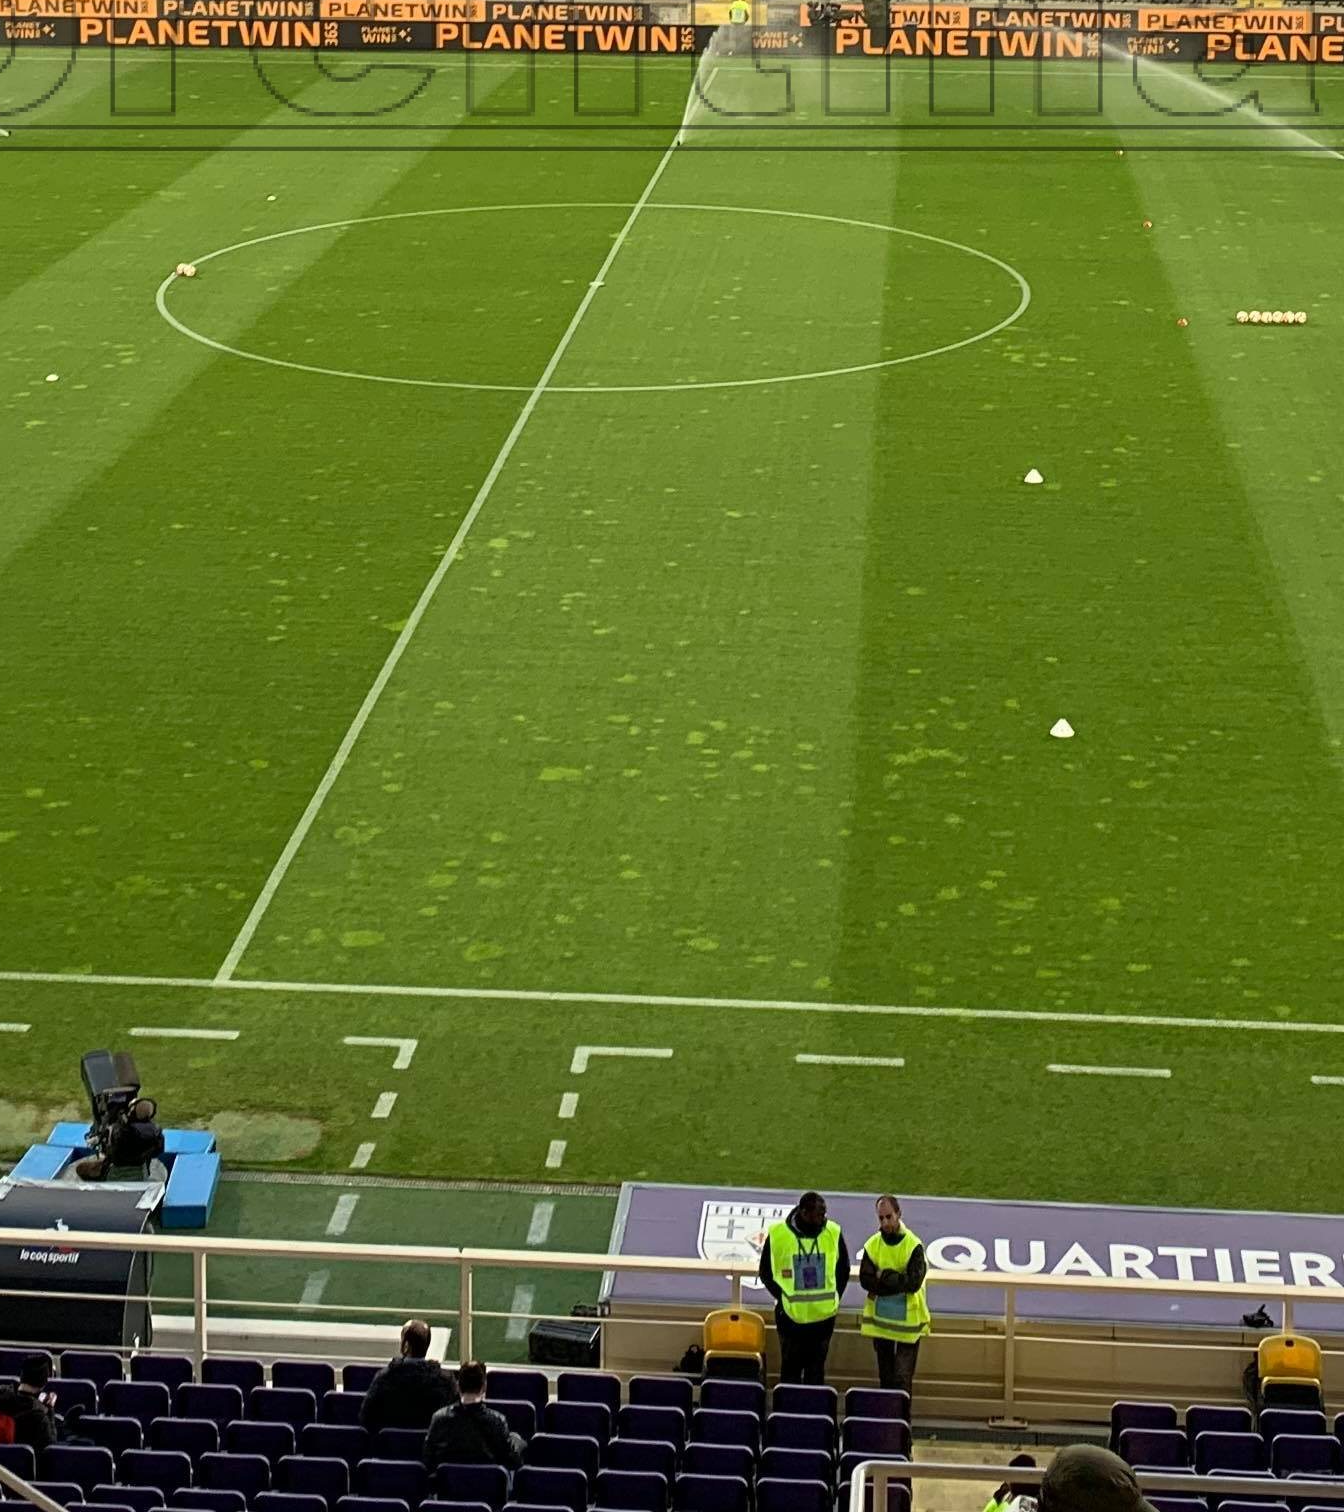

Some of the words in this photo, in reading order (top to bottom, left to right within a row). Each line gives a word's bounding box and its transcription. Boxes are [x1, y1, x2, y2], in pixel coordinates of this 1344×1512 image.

[0, 0, 138, 15] PLANETWIN
[163, 0, 307, 16] PLANETWIN
[329, 1, 467, 18] PLANETWIN
[493, 4, 634, 21] PLANETWIN
[976, 12, 1120, 29] PLANETWIN
[1147, 14, 1293, 30] PLANETWIN
[80, 19, 320, 46] PLANETWIN
[437, 25, 677, 52] PLANETWIN
[836, 28, 1082, 57] PLANETWIN
[19, 1248, 28, 1261] le
[30, 1250, 48, 1264] coq
[48, 1251, 80, 1265] sportif
